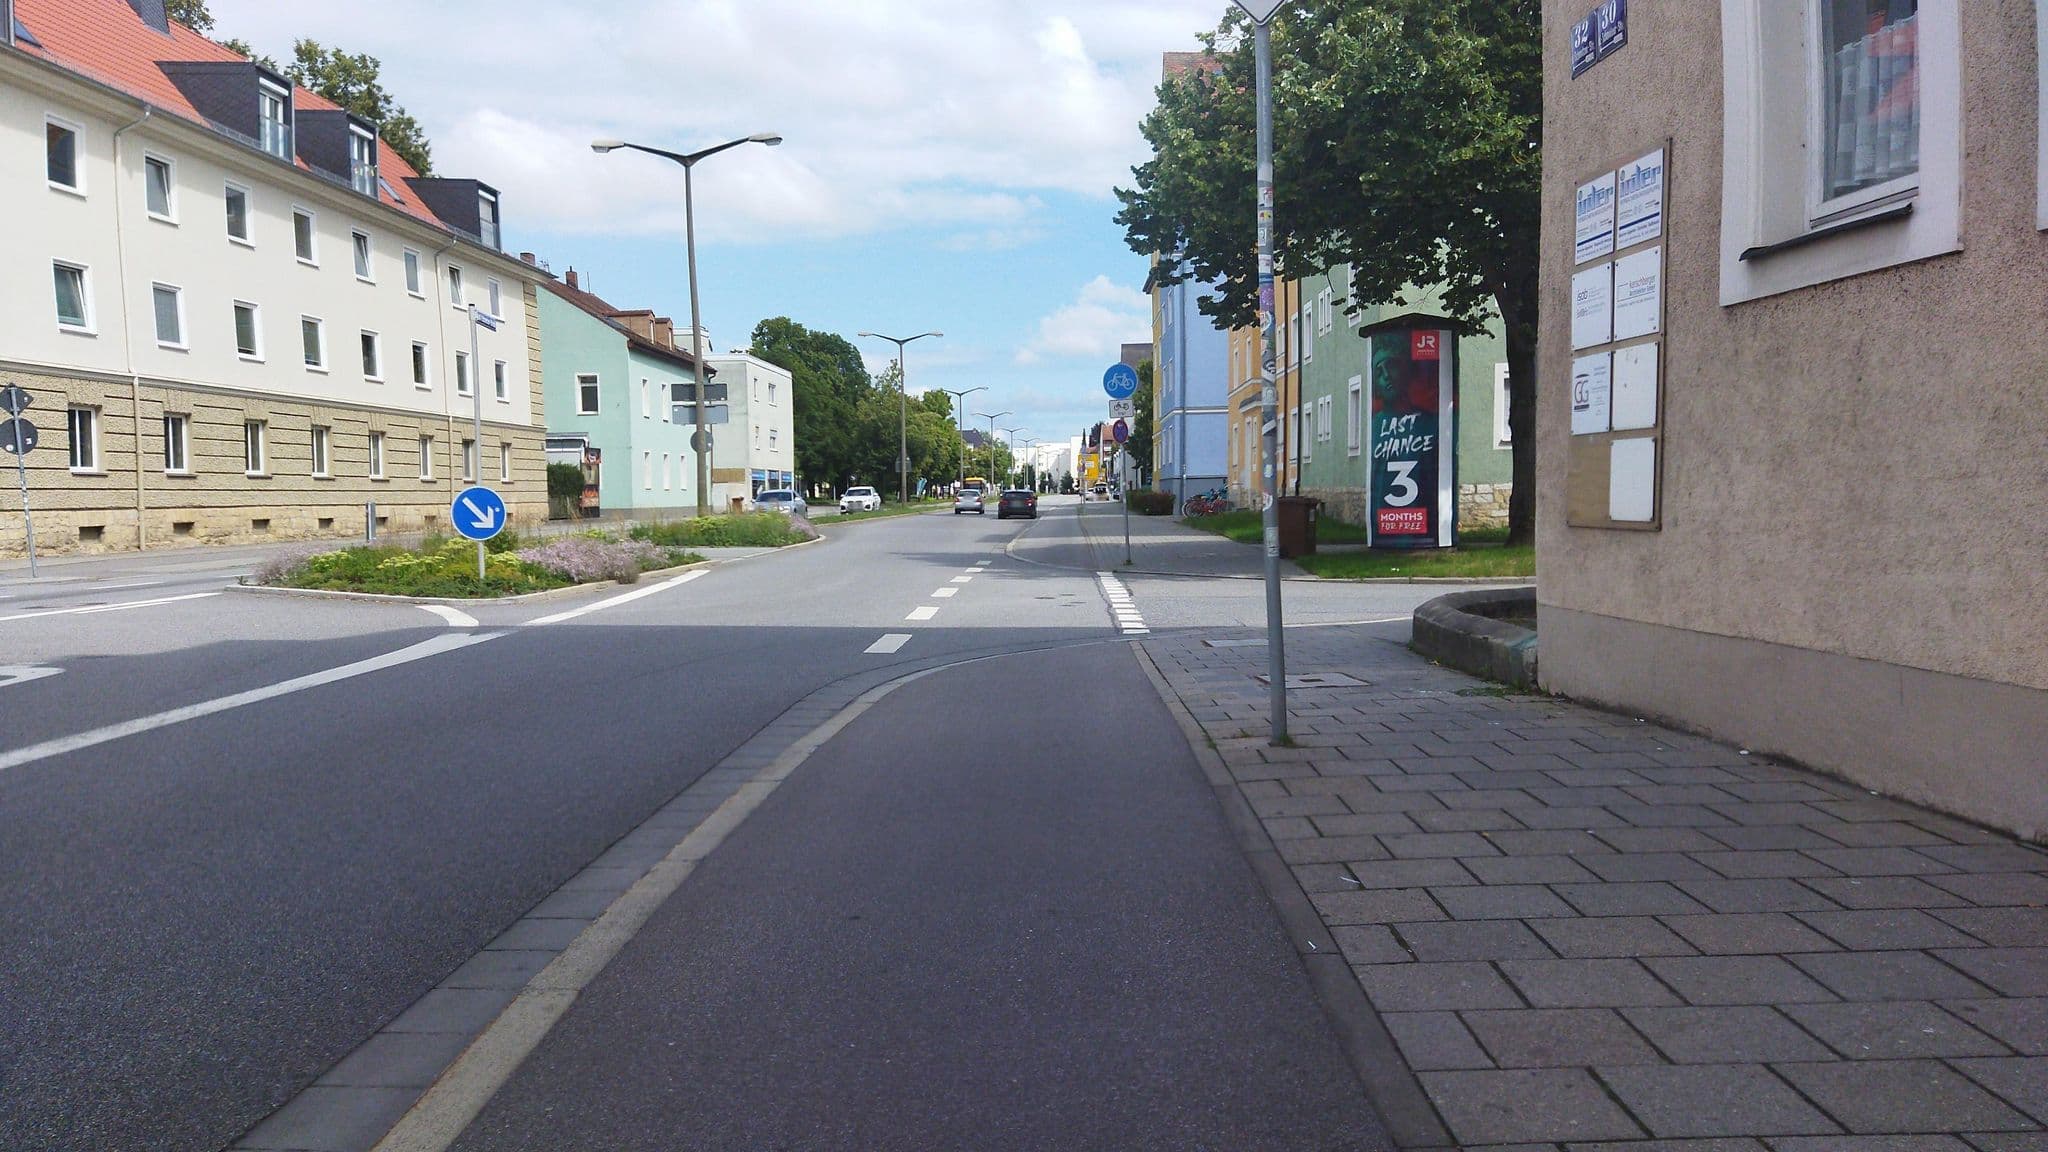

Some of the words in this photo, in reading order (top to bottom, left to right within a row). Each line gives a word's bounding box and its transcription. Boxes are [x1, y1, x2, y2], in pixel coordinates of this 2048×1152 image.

[1601, 0, 1616, 29] 30
[1574, 20, 1588, 48] 32
[1417, 335, 1435, 348] JR
[1380, 412, 1420, 437] LAST
[1374, 434, 1434, 460] CHANCE
[1383, 460, 1419, 507] 3
[1380, 512, 1423, 521] MONTHS
[1381, 522, 1396, 530] FOR
[1398, 522, 1422, 530] FREE
